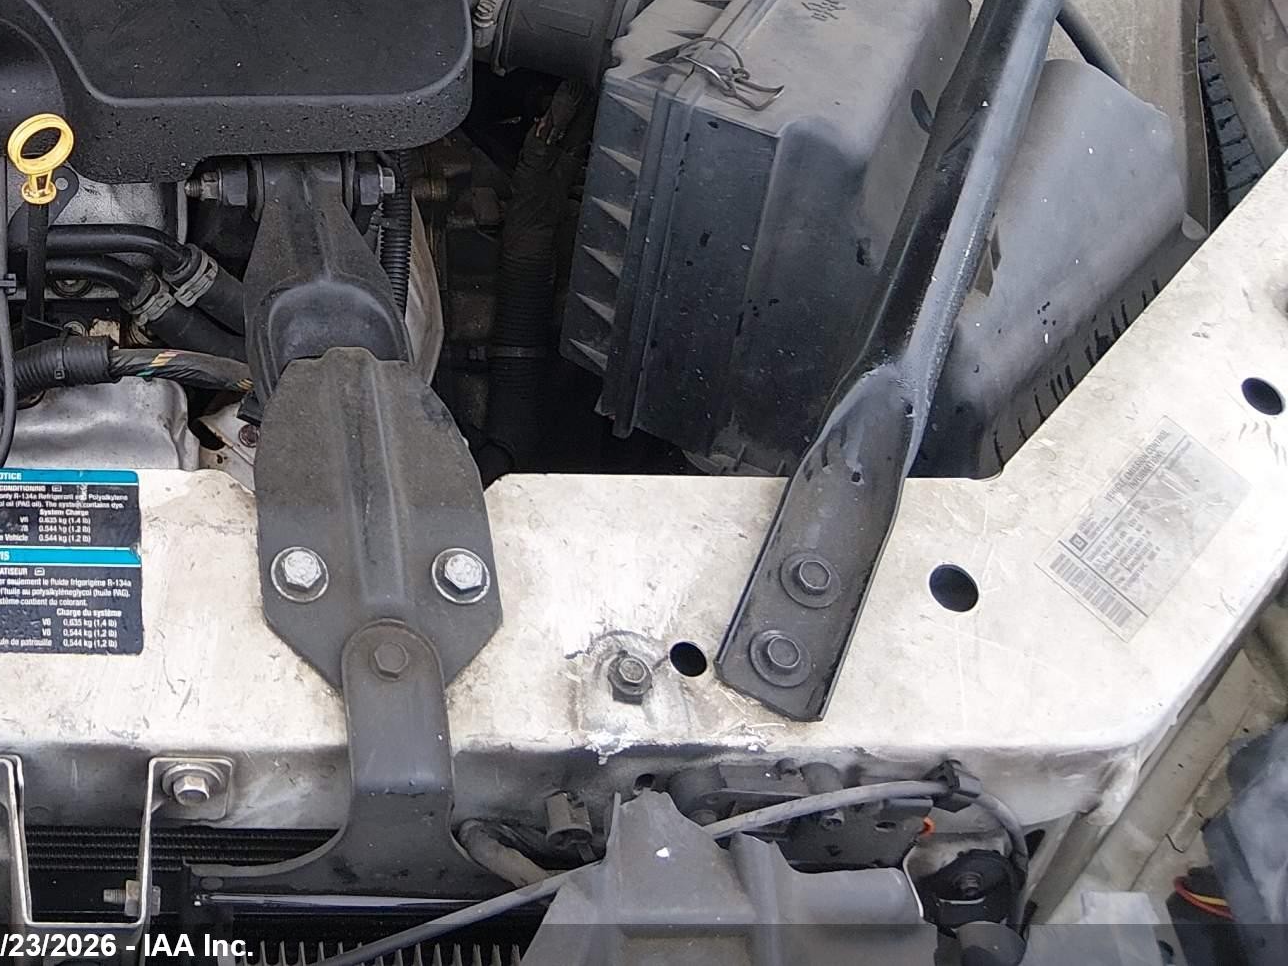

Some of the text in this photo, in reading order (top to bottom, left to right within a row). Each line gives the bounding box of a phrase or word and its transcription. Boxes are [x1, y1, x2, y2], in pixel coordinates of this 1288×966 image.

[58, 534, 67, 542] kg
[43, 578, 49, 586] le
[51, 578, 69, 586] fluide
[108, 579, 132, 587] R-134a
[22, 588, 31, 596] au
[21, 597, 48, 605] contient
[57, 608, 82, 617] Charge
[83, 608, 92, 617] du
[83, 618, 92, 627] kg
[84, 629, 92, 638] kg
[84, 639, 92, 648] kg
